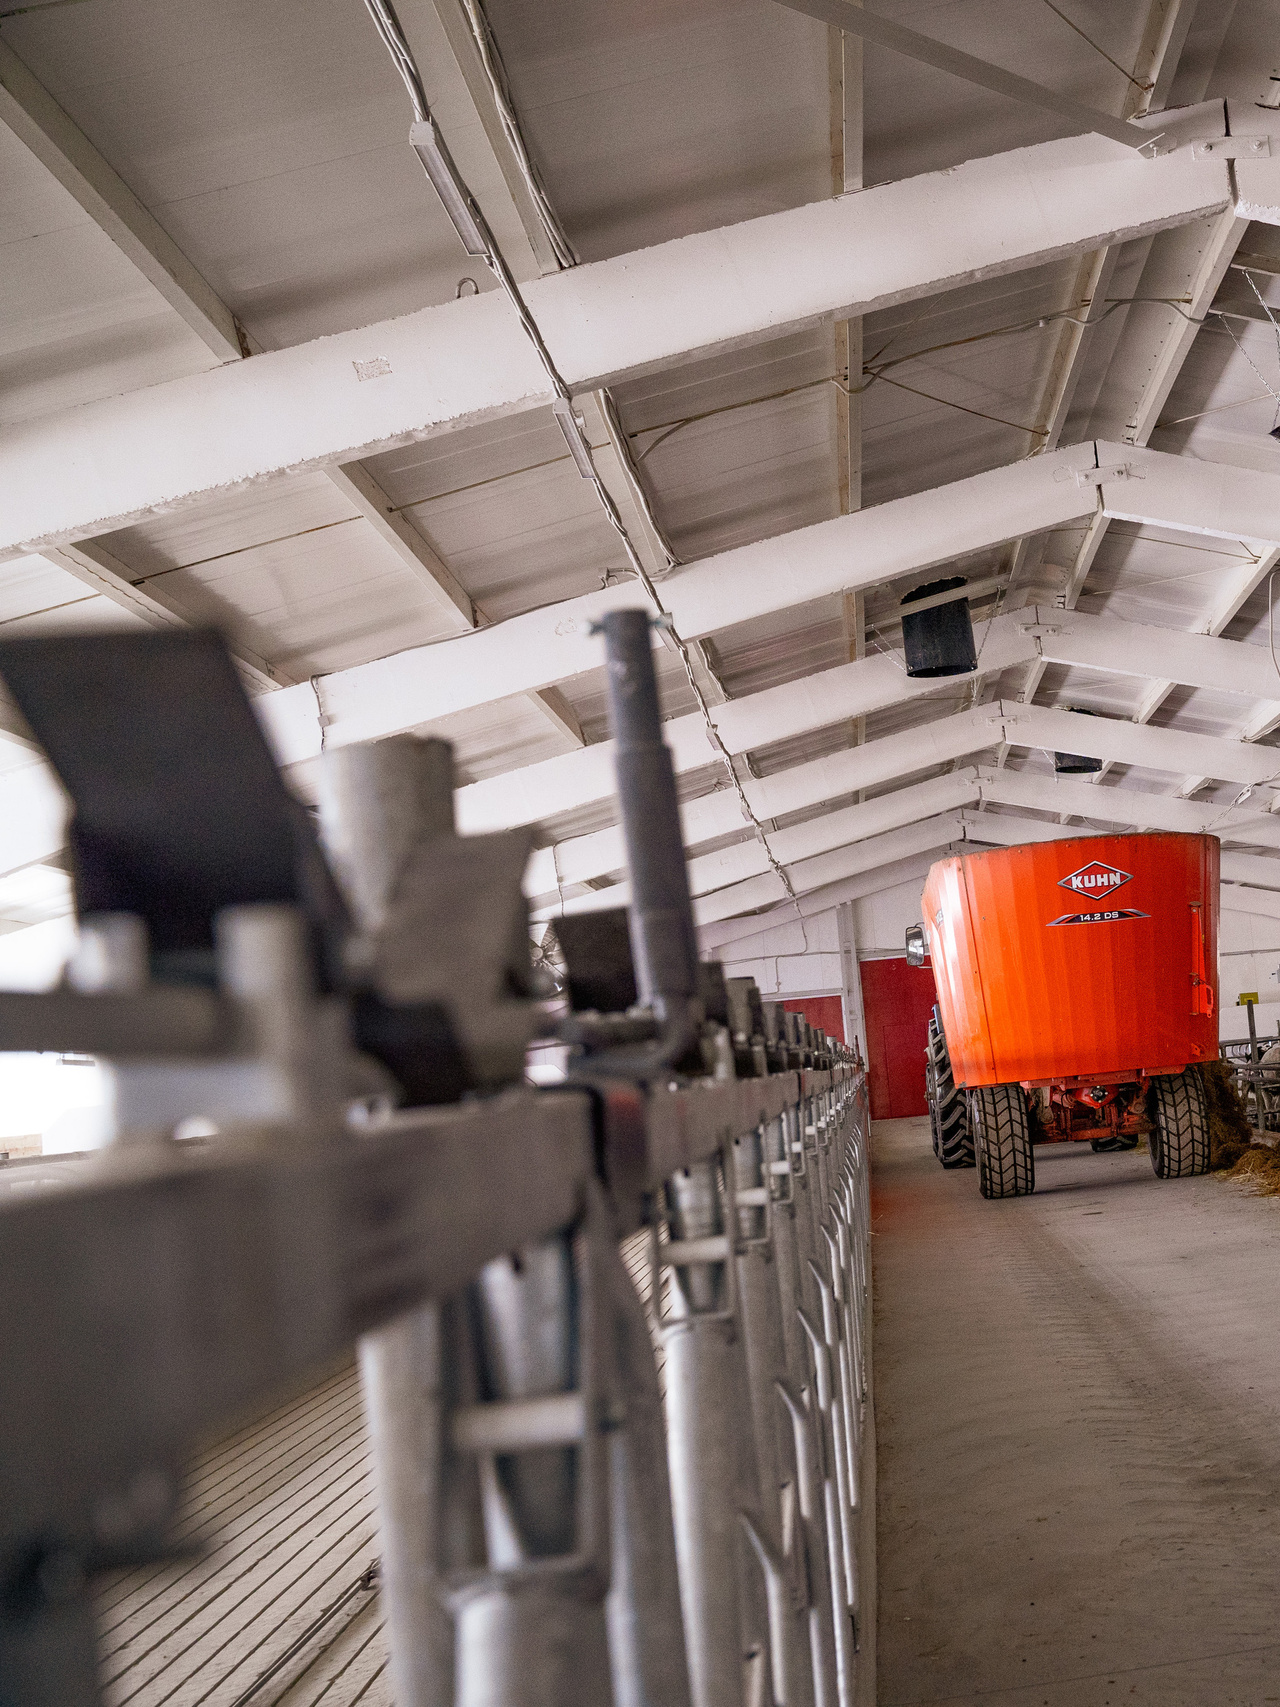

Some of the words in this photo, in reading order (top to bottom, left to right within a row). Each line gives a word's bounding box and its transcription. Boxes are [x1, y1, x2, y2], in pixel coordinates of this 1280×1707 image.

[1071, 872, 1121, 889] KUHN
[1080, 913, 1101, 922] 14.2
[1104, 911, 1119, 919] DS
